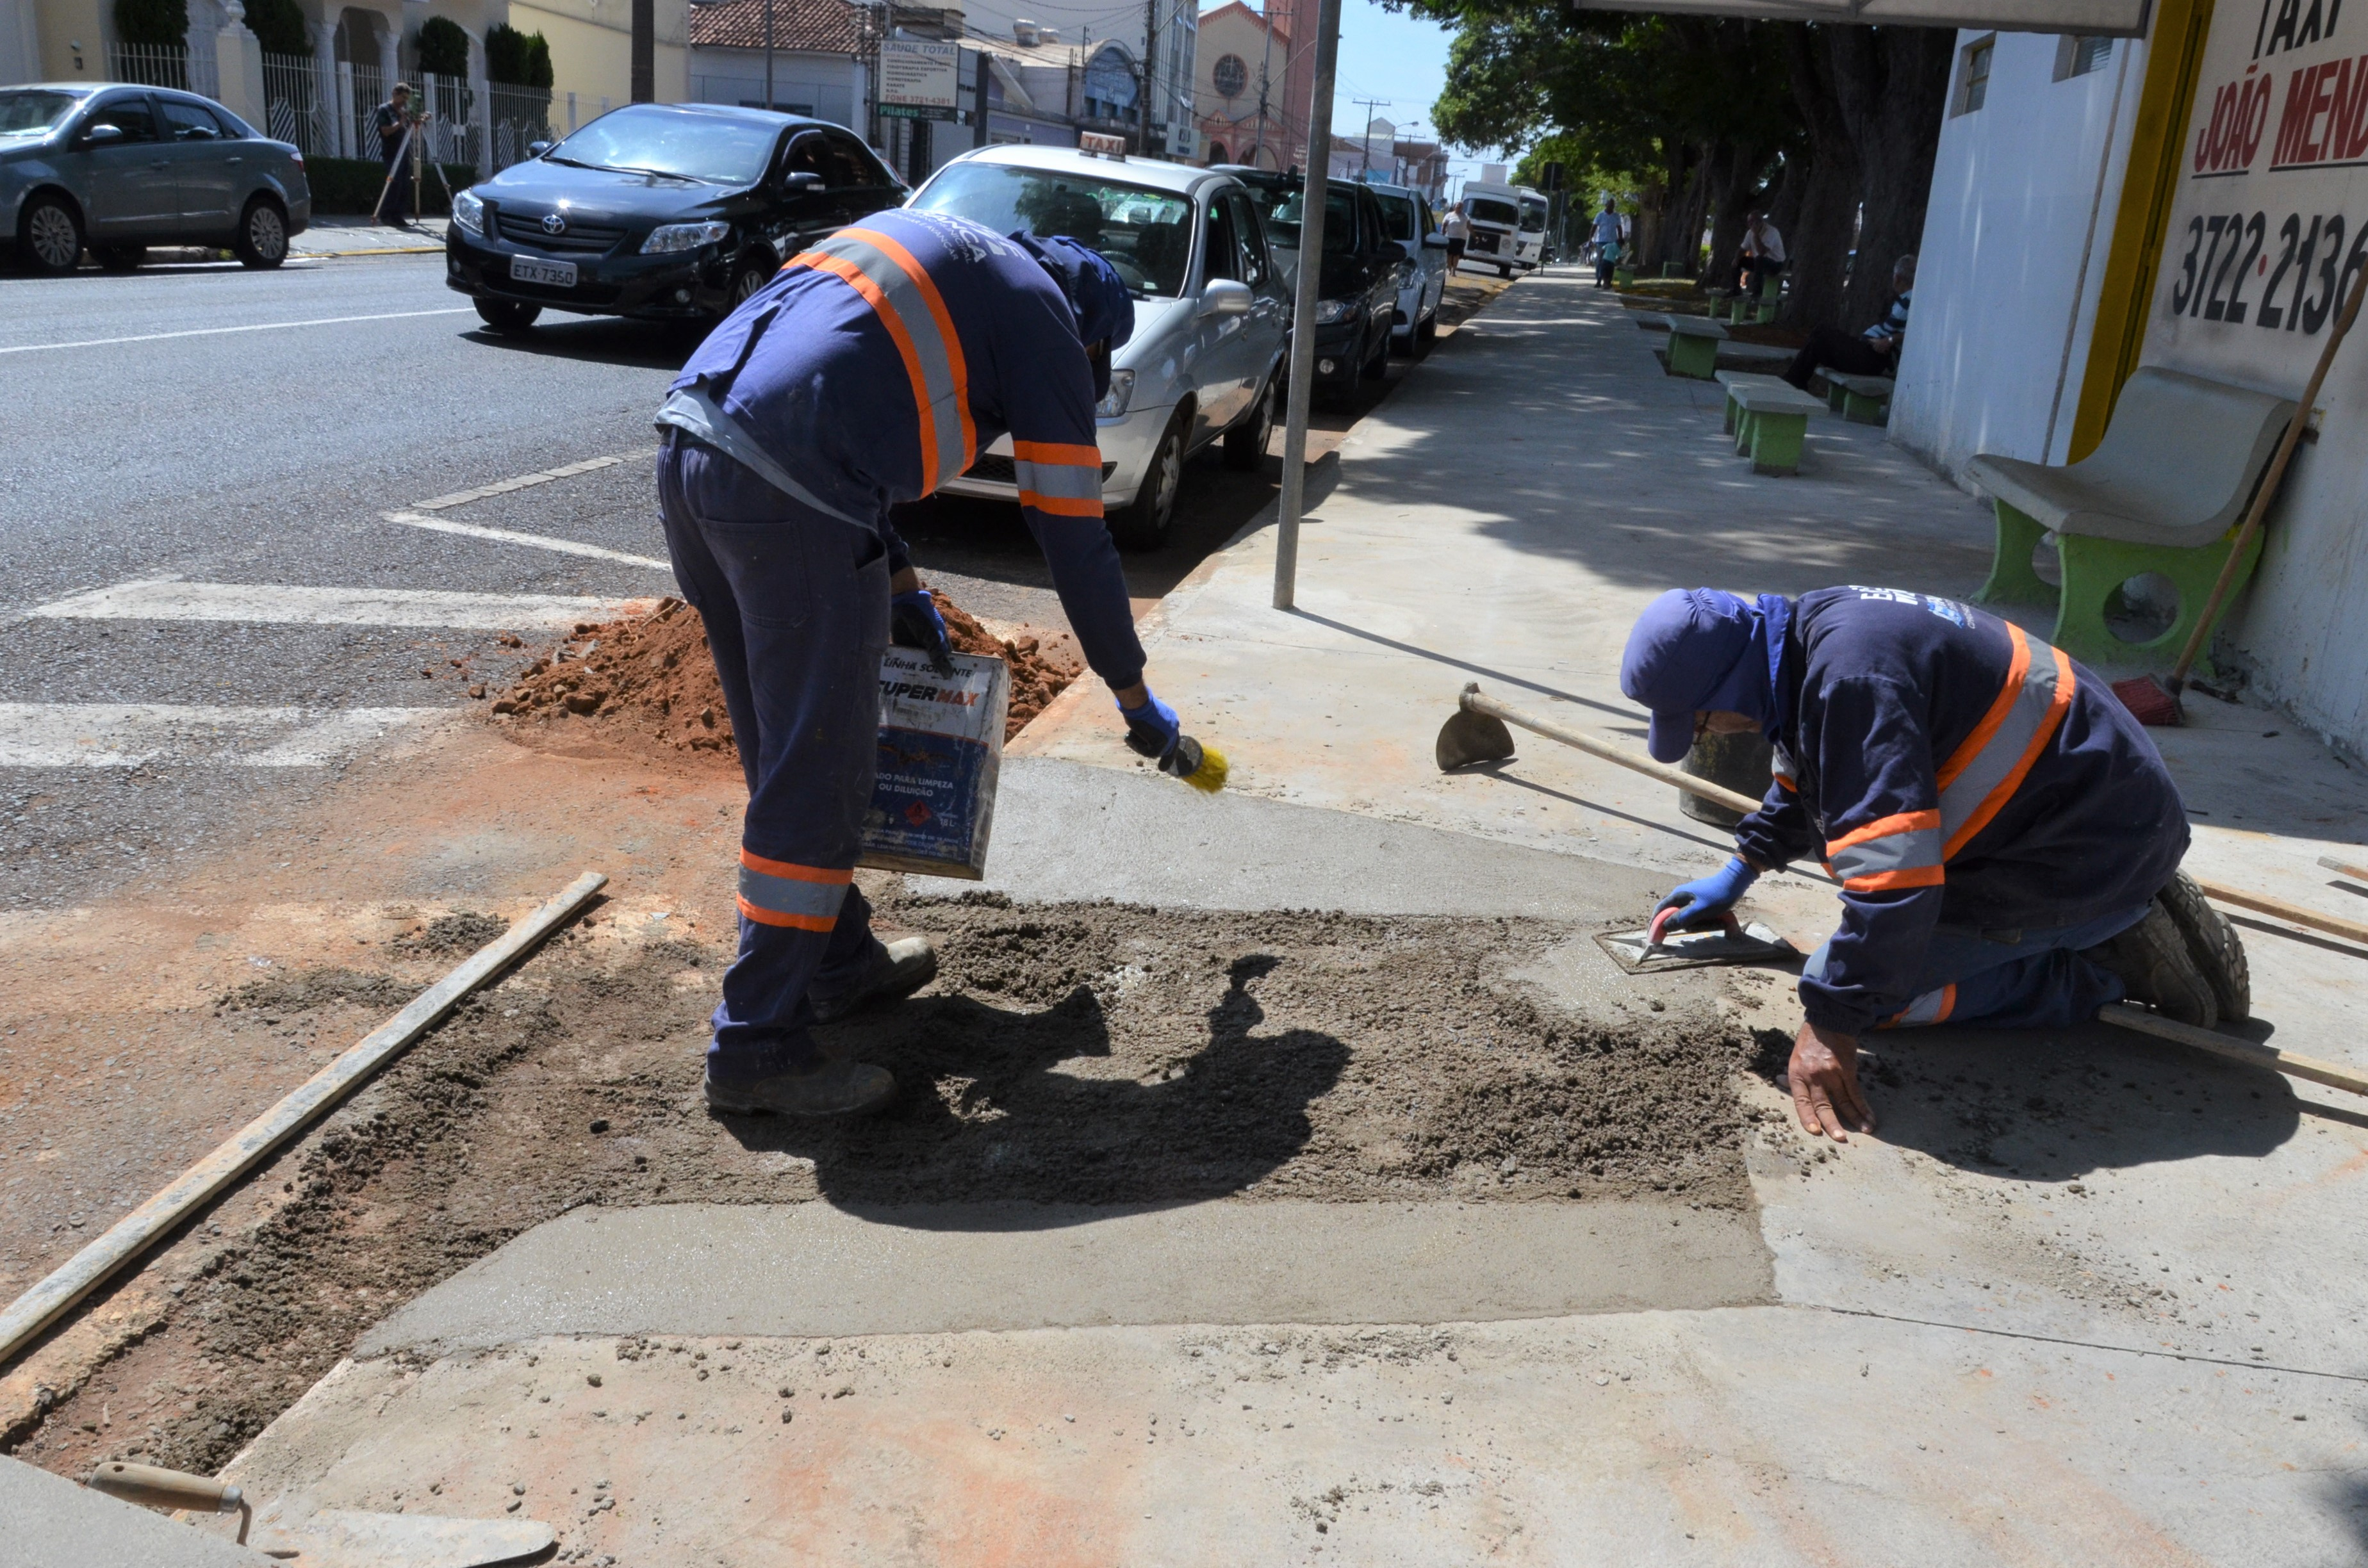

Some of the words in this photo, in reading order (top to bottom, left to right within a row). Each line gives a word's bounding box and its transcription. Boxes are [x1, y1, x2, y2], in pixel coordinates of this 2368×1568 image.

[923, 45, 956, 55] TOTAL
[885, 94, 907, 102] FONE
[879, 105, 919, 117] Pilates
[2193, 62, 2271, 172] JOÃO
[1085, 136, 1121, 153] TAXI
[919, 663, 973, 678] SOLNTE
[893, 774, 916, 784] PARA
[918, 778, 954, 790] LIMPEZA
[878, 783, 892, 791] OU
[894, 785, 933, 797] DILUIÇÃO
